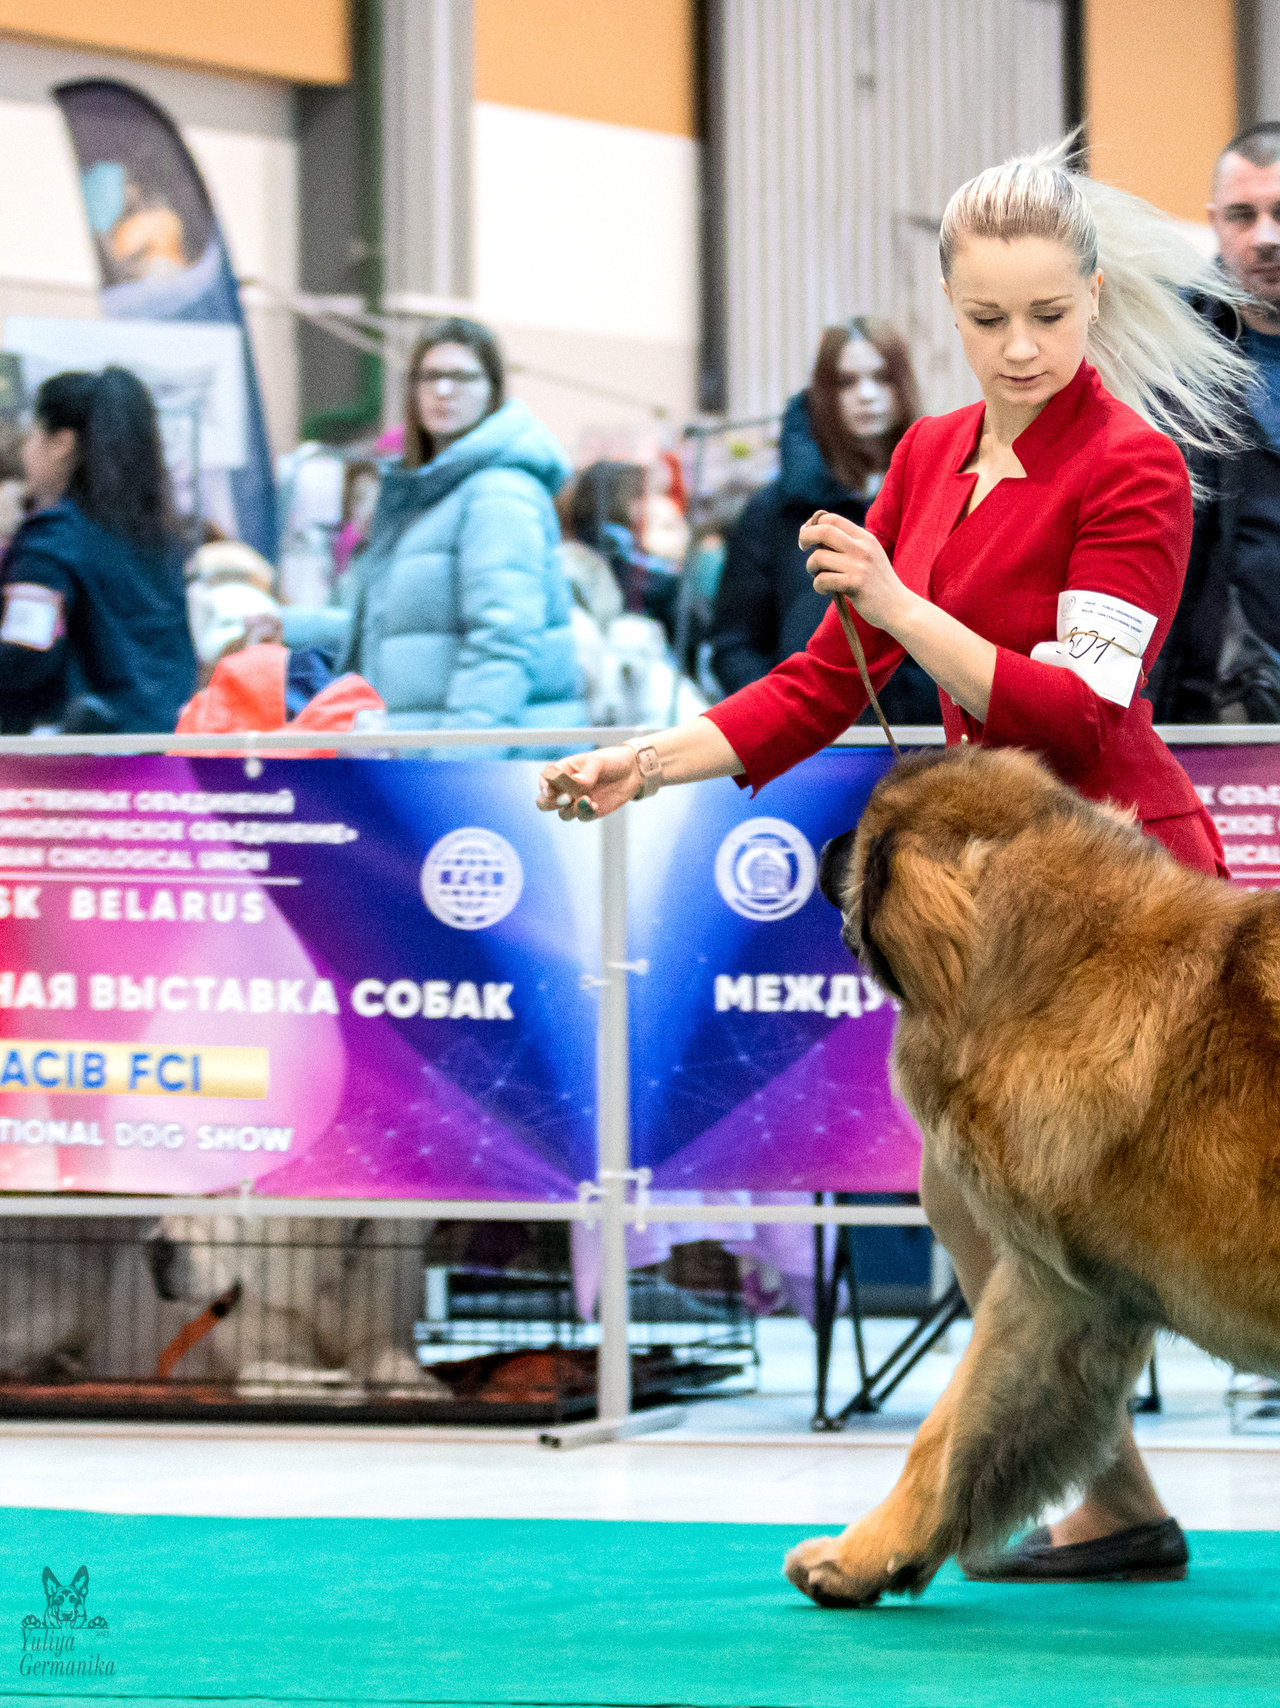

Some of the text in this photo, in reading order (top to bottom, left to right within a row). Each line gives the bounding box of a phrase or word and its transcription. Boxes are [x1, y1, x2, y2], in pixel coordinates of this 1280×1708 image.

[135, 788, 295, 814] ОБЪЕДИНЕНИЙ
[197, 850, 270, 871] UNION
[70, 886, 265, 923] BELARUS
[90, 973, 340, 1015] ВЫСТАВКА
[352, 978, 515, 1021] СОБАК
[714, 973, 901, 1018] МЕЖДУ
[127, 1052, 202, 1092] FCI
[114, 1122, 185, 1149] DOG
[197, 1124, 294, 1152] SHOW
